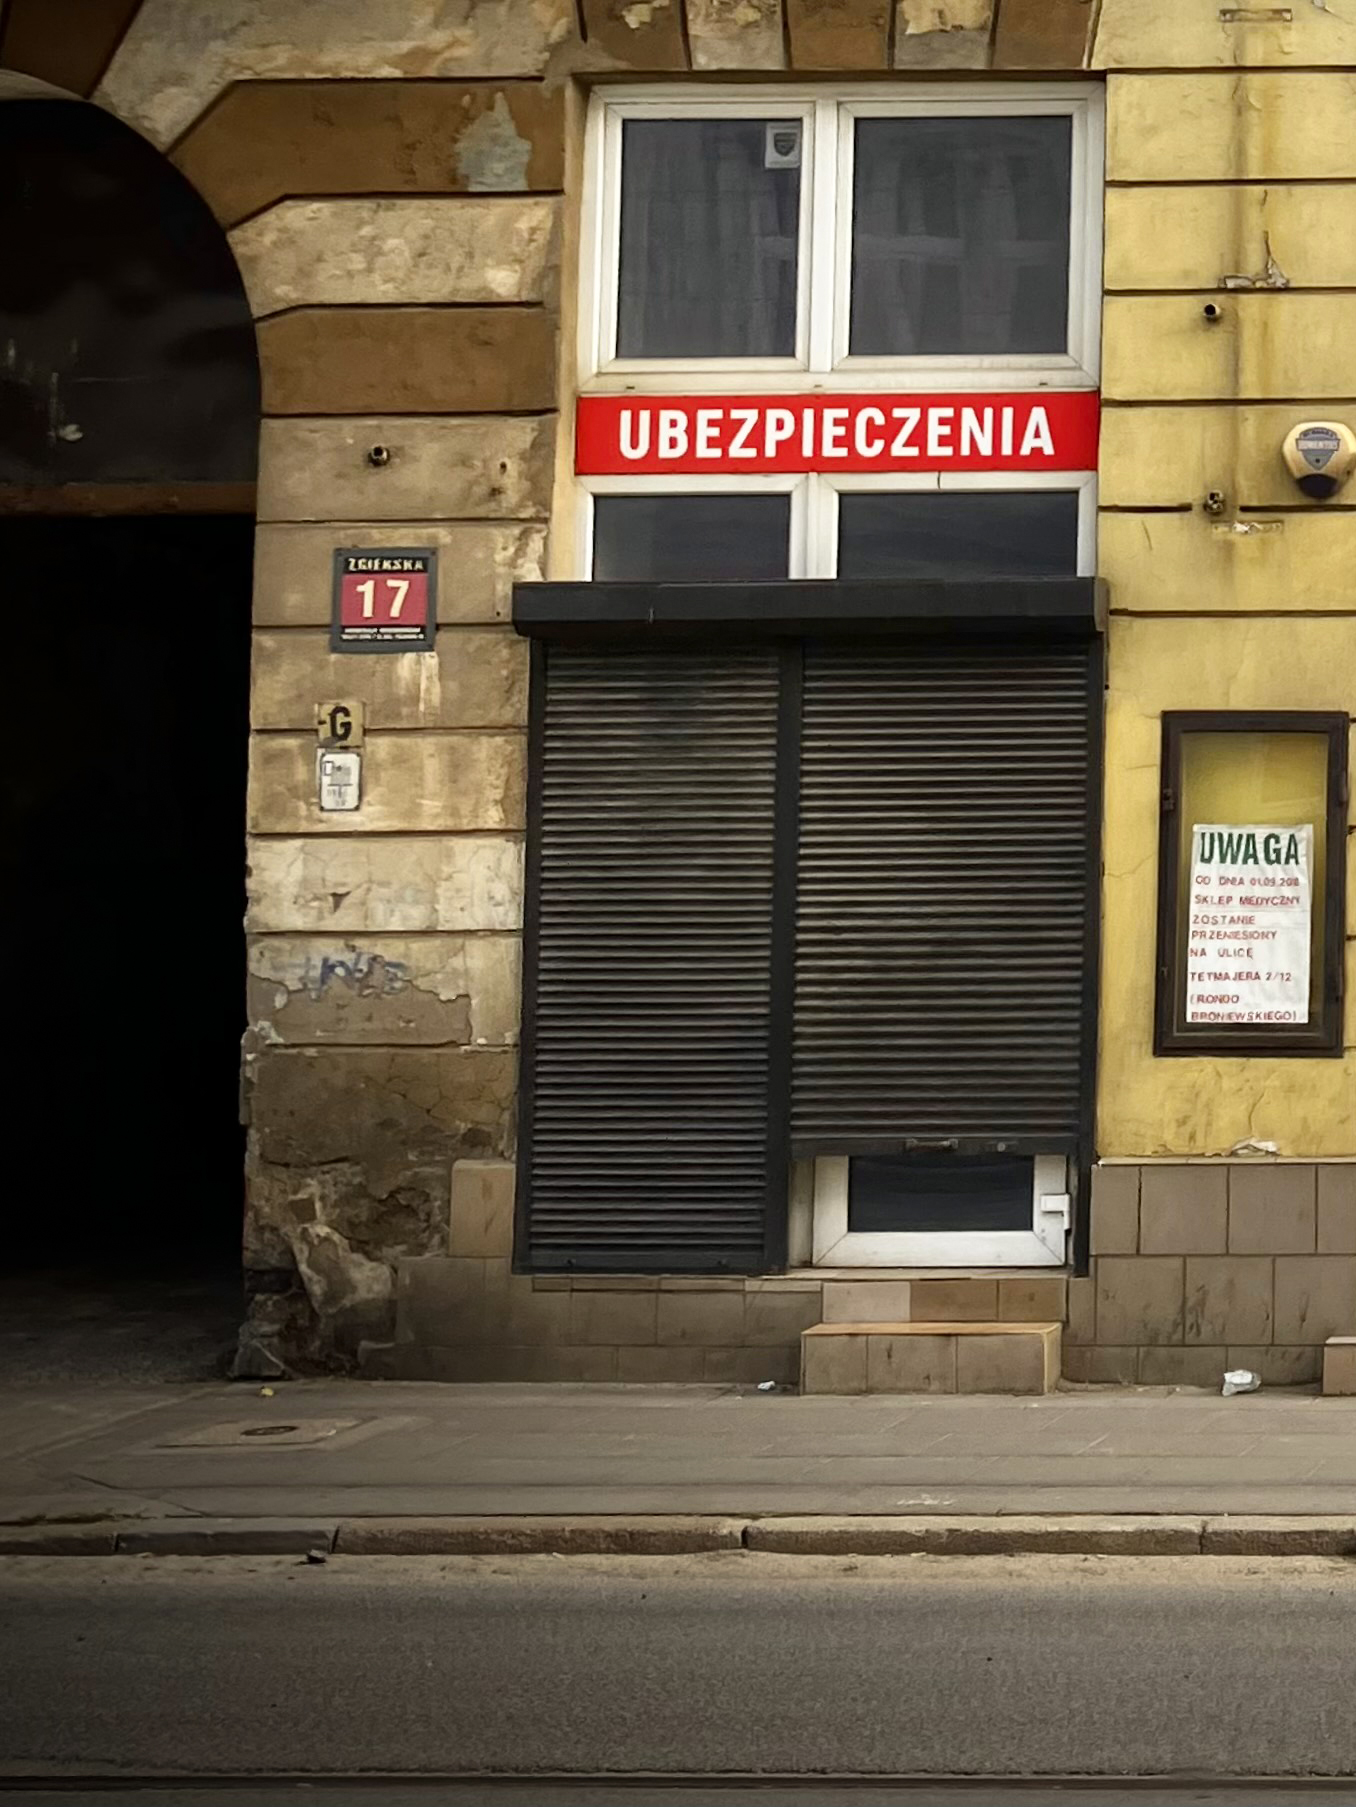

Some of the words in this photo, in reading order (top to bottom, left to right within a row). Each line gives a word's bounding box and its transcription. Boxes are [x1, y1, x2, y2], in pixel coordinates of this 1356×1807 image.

[619, 406, 1055, 459] UBEZPIECZENIA
[355, 579, 410, 618] 17
[329, 705, 352, 741] G
[1200, 832, 1300, 865] UWAGA
[1195, 894, 1233, 905] SKLEP
[1239, 896, 1300, 906] MEDYCZNY
[1192, 914, 1256, 925] ZOSTANIE
[1191, 931, 1277, 940] PRZENIESIONY
[1189, 948, 1207, 957] NA
[1217, 948, 1254, 960] ULICĘ
[1190, 972, 1260, 982] TETMAJERA
